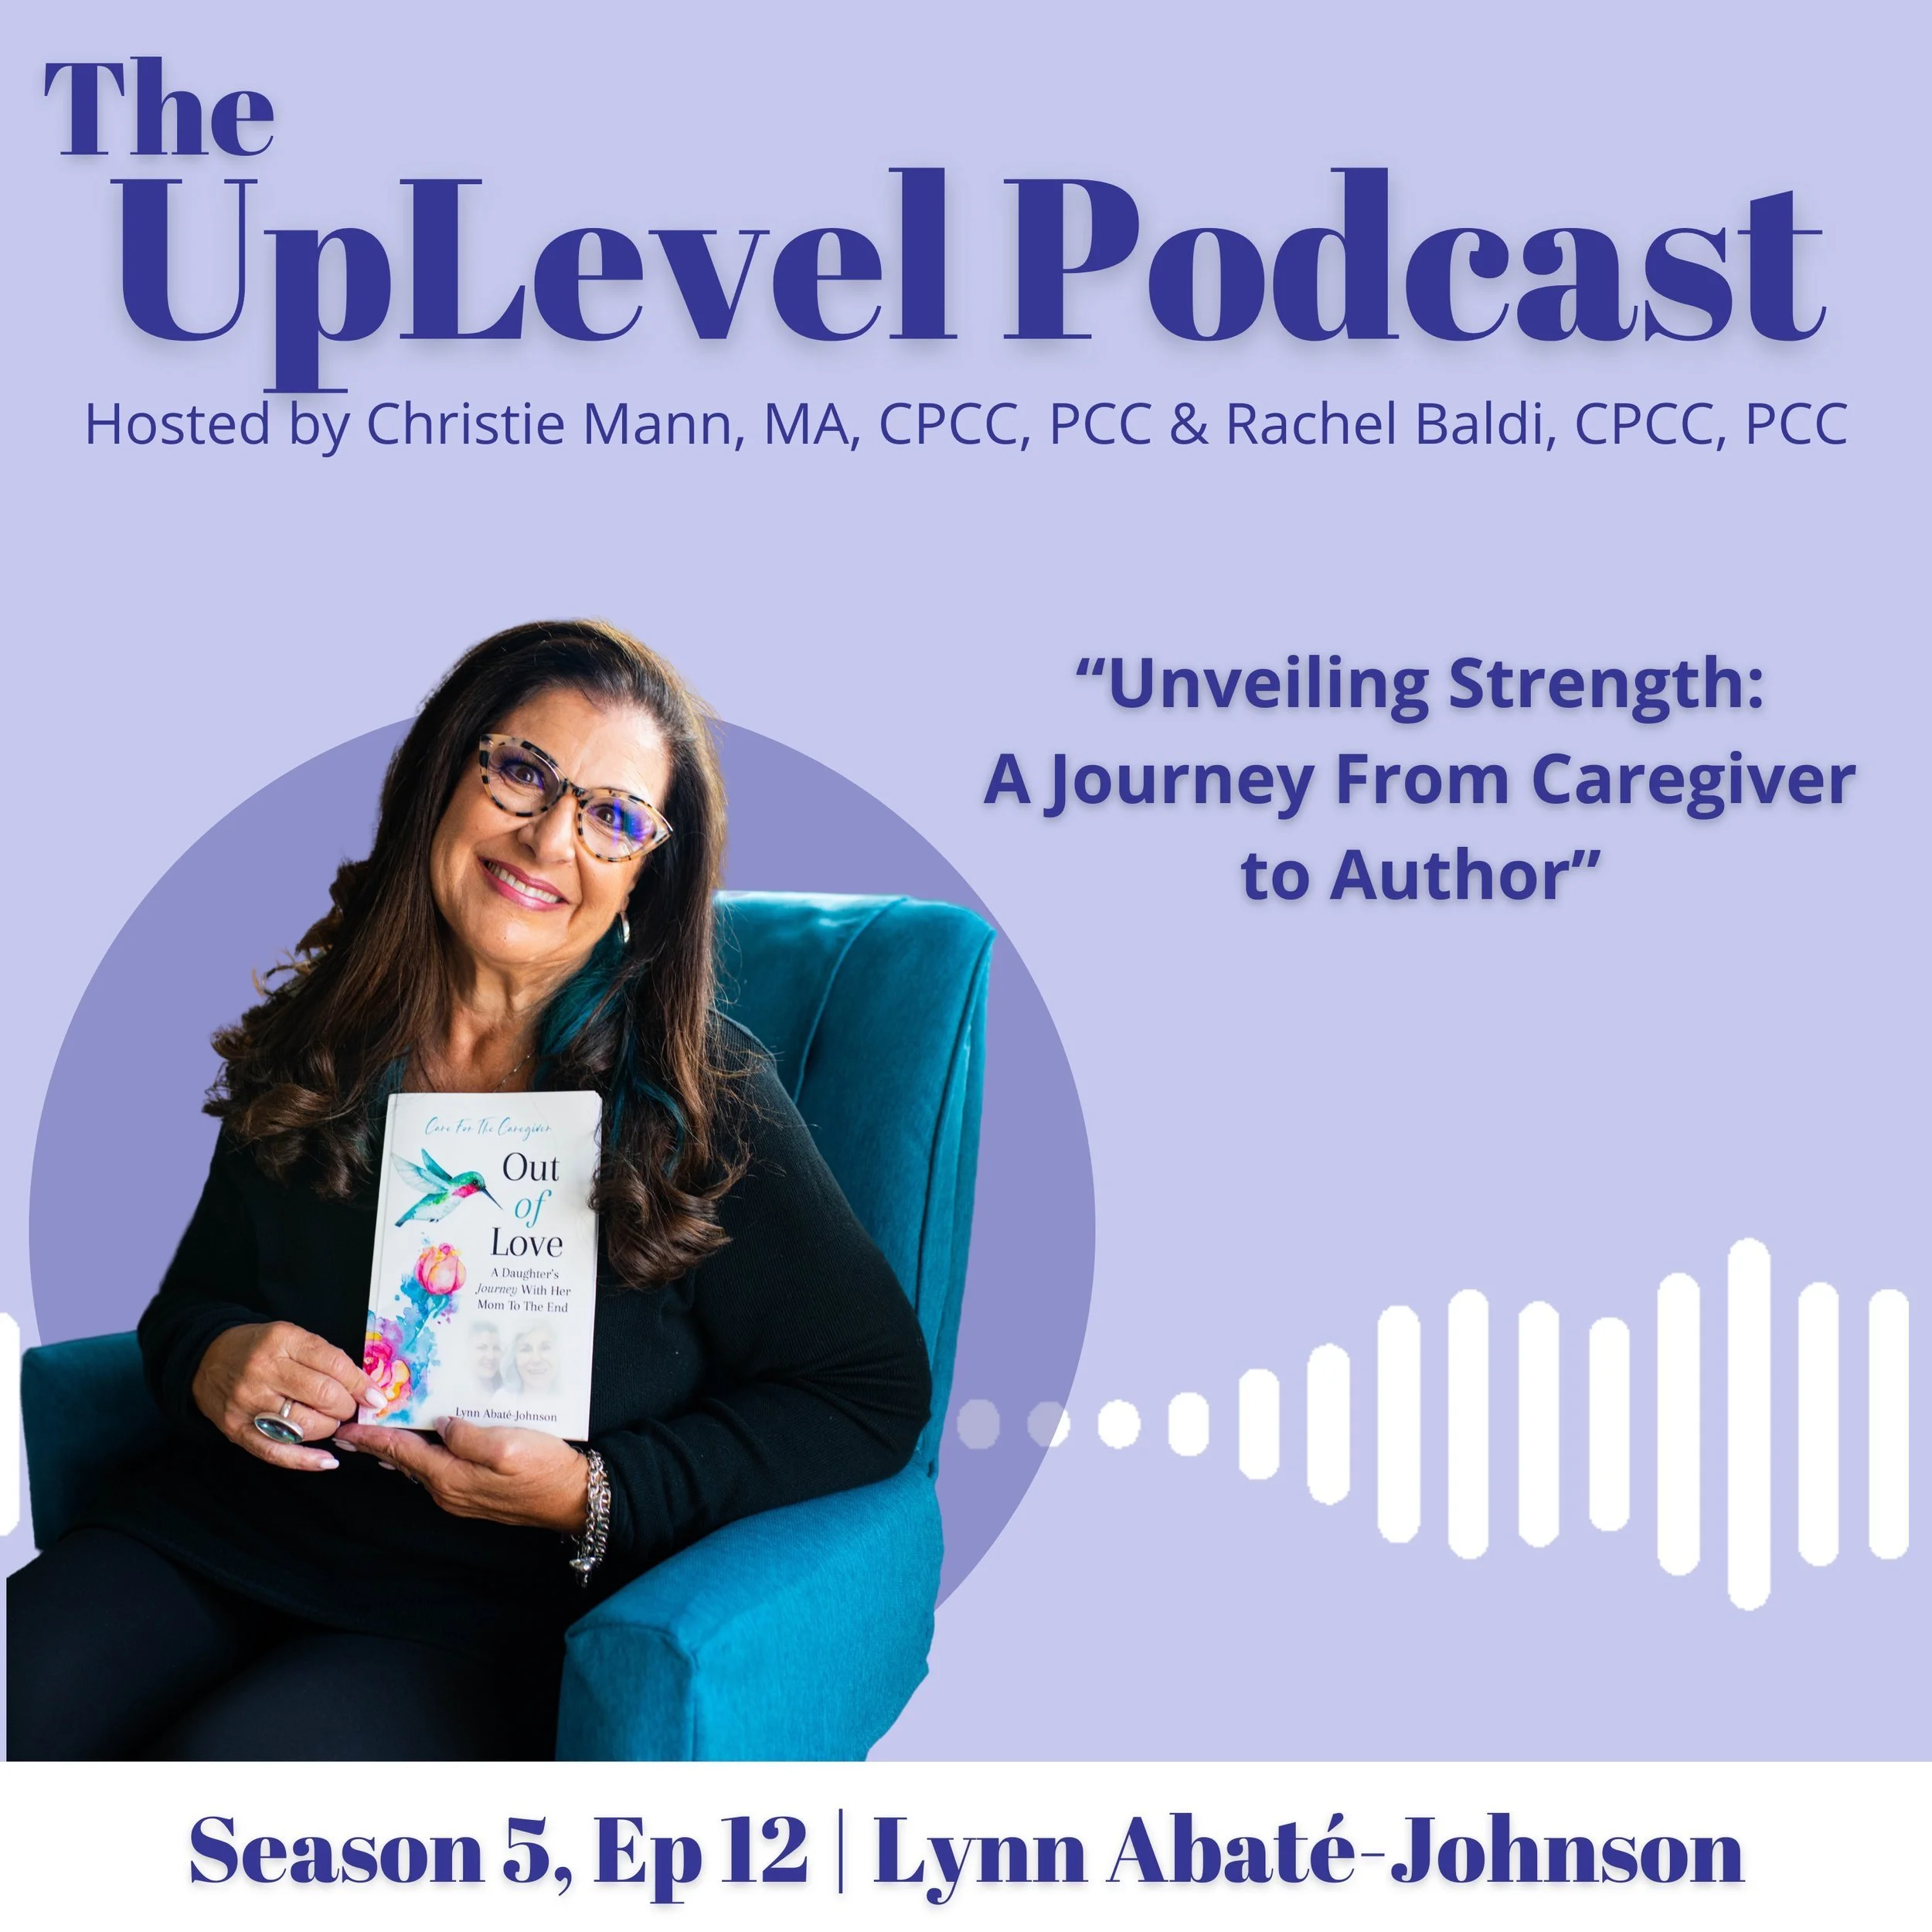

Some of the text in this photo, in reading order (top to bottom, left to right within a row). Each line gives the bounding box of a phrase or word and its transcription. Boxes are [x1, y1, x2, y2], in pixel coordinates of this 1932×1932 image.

[424, 1117, 553, 1141] Care For The Caregiver
[502, 1151, 560, 1182] Out
[514, 1189, 553, 1229] of
[490, 1226, 563, 1258] Love
[491, 1267, 498, 1277] A
[474, 1283, 572, 1297] Journey With Her
[478, 1299, 568, 1312] Mom To The End
[456, 1406, 557, 1422] Lynn Abaté-Johnson
